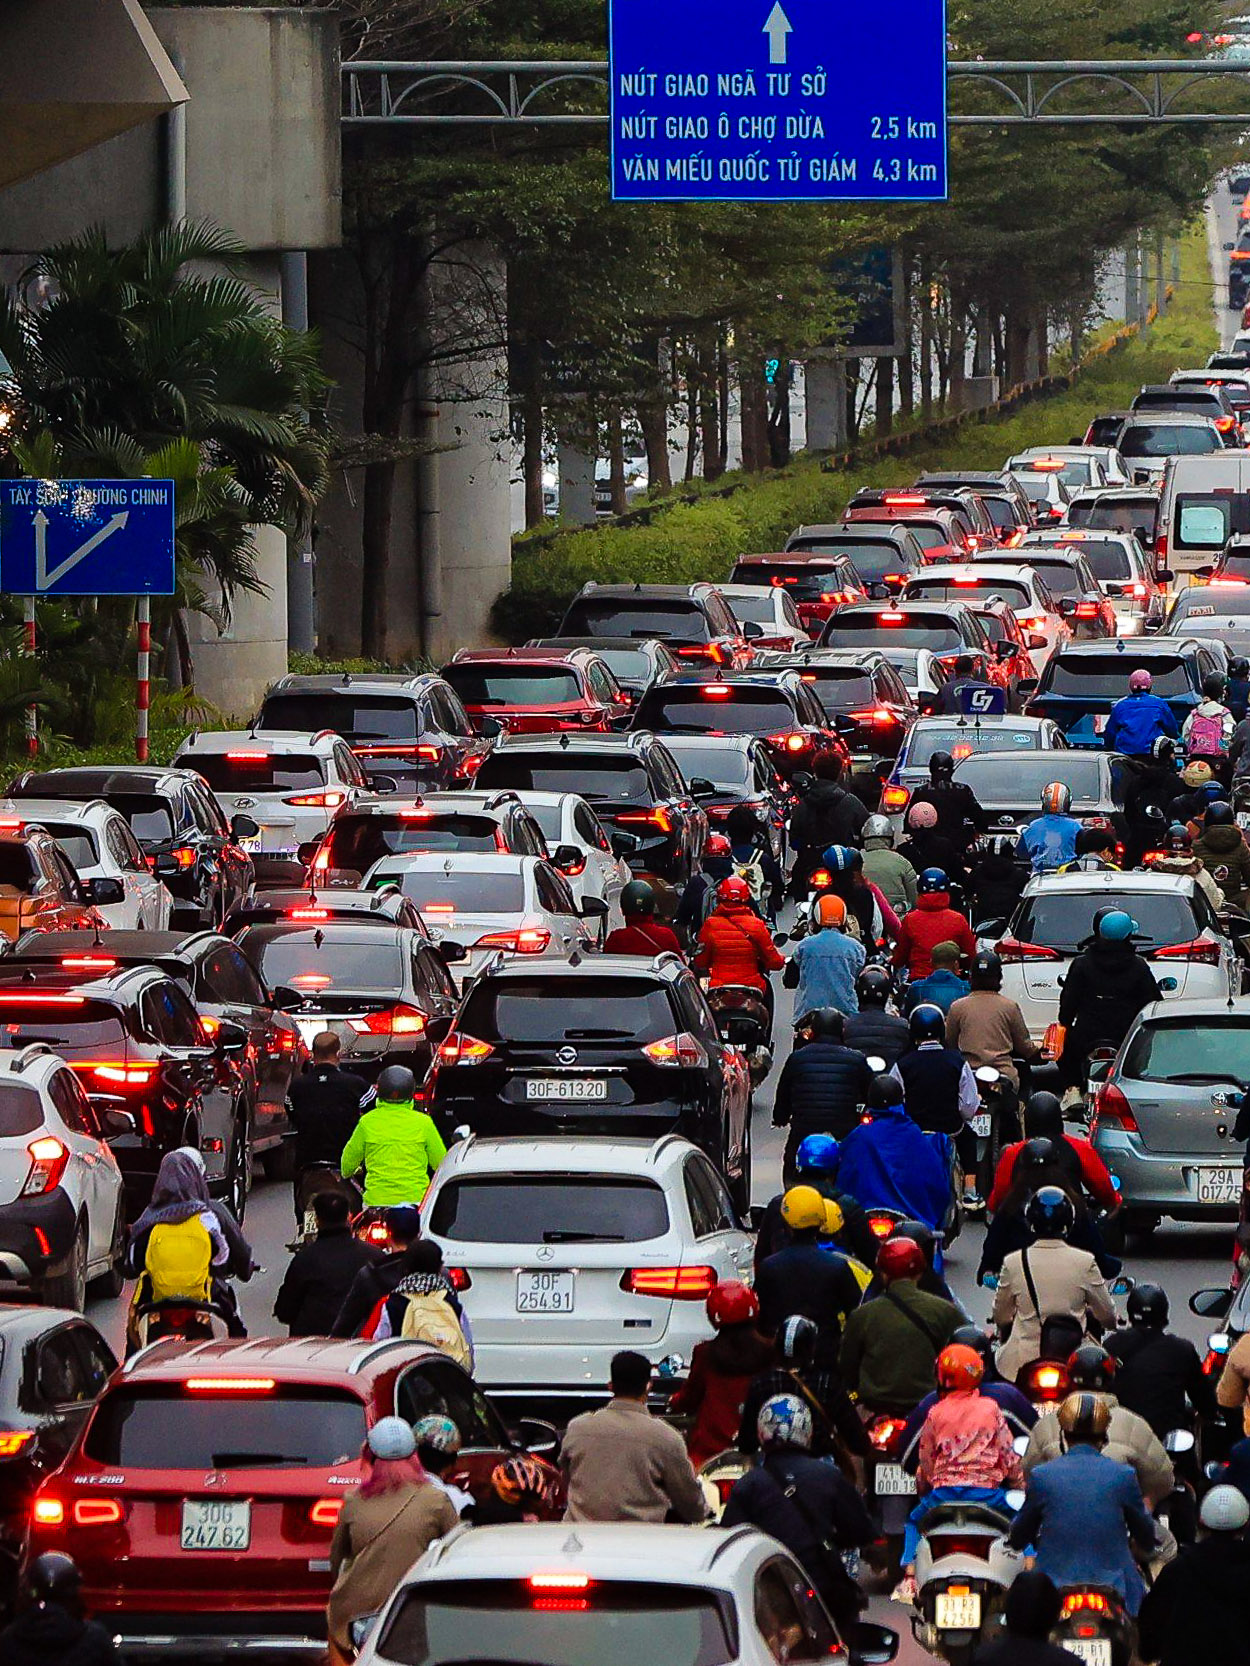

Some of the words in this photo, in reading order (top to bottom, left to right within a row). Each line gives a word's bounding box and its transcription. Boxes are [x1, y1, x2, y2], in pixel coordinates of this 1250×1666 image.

[620, 66, 658, 96] NÚT
[665, 73, 709, 97] GIAO
[718, 69, 756, 96] NGÃ
[766, 72, 792, 96] TƯ
[801, 66, 827, 96] SỞ
[621, 109, 658, 139] NÚT
[665, 116, 709, 139] GIAO
[718, 112, 729, 139] Ô
[738, 115, 777, 143] CHỢ
[786, 109, 825, 139] DỪA
[871, 117, 900, 140] 2,5
[907, 117, 937, 139] km
[622, 153, 659, 181] VĂN
[666, 150, 712, 182] MIẾU
[720, 150, 770, 183] QUỐC
[778, 152, 801, 182] TỬ
[809, 153, 857, 182] GIÁM
[873, 159, 901, 183] 4,3
[907, 159, 937, 181] km
[9, 486, 32, 505] TÂY
[131, 488, 168, 505] CHINH
[971, 689, 994, 712] G7
[528, 1082, 604, 1098] 30F-613.20
[1209, 1170, 1234, 1185] 29A
[1201, 1185, 1243, 1200] 017.75
[531, 1274, 561, 1290] 30F
[519, 1292, 571, 1309] 254.91
[184, 1526, 245, 1548] 247.62
